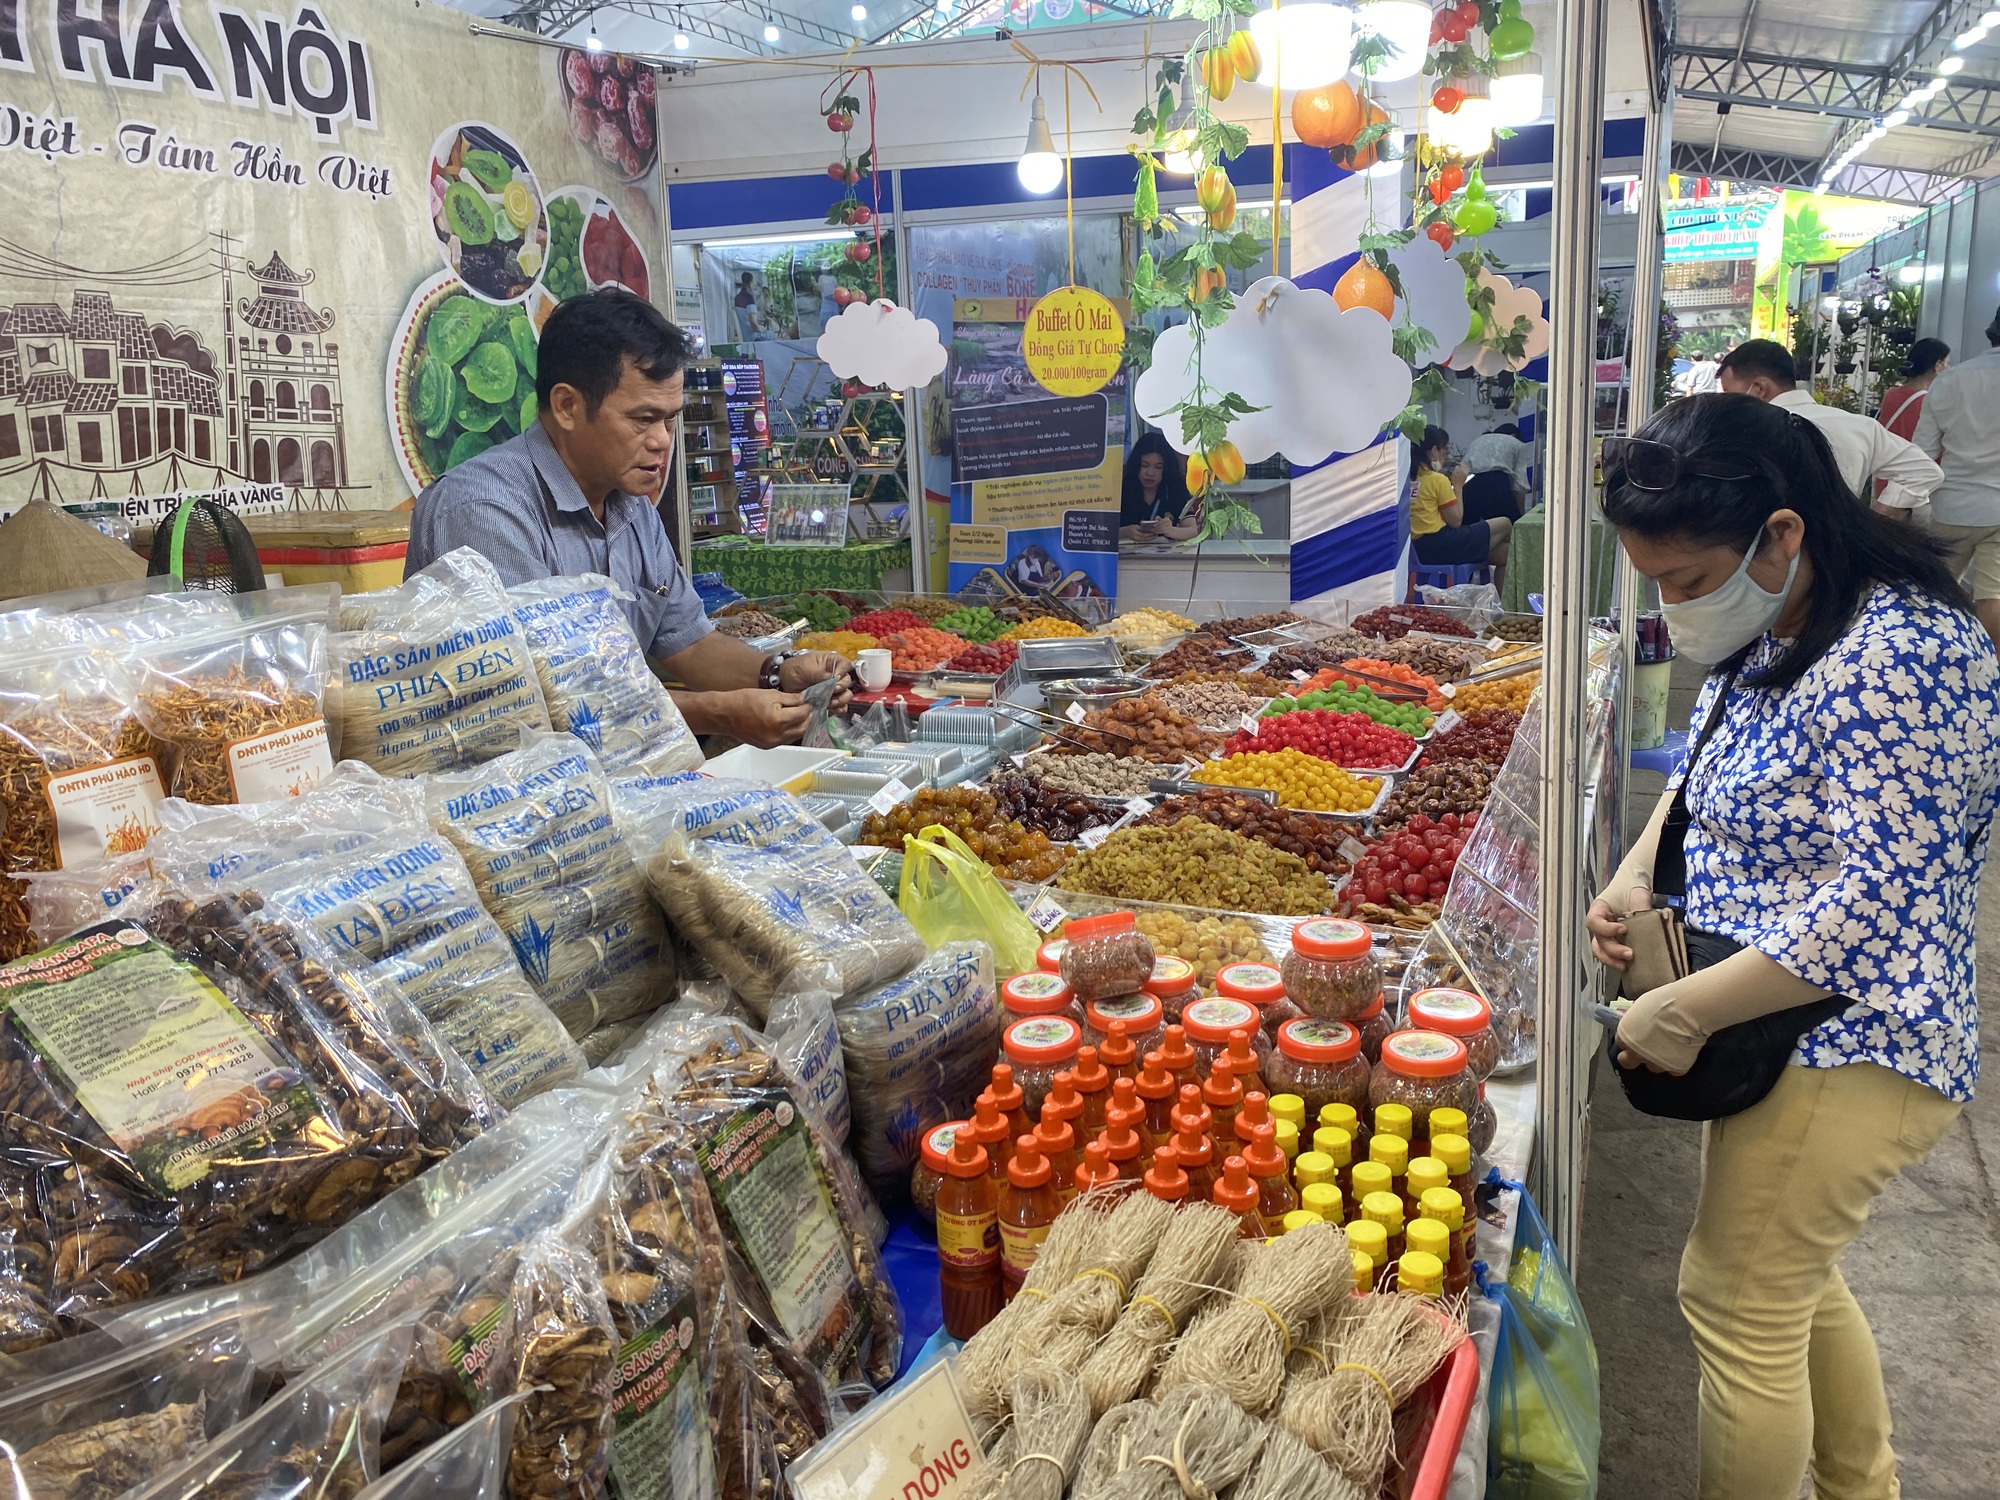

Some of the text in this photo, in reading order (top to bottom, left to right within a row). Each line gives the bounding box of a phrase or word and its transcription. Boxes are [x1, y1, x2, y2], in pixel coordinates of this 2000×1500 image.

[219, 8, 372, 135] NỘI
[119, 123, 218, 173] Tâm
[230, 140, 306, 185] Hồn
[318, 155, 392, 200] Việt
[1037, 308, 1072, 332] Buffet
[1075, 302, 1085, 331] Ô
[1089, 307, 1112, 330] Mai
[1029, 337, 1119, 359] Đồng Giá Tự Chọn
[953, 366, 996, 392] Làng
[1042, 366, 1107, 381] 20.000/100gram
[121, 497, 149, 521] IỆN
[240, 485, 284, 502] VÀNG
[348, 615, 515, 684] ĐẶC SẢN MIẾN DONG
[375, 647, 514, 710] PHIA ĐÉN
[376, 719, 400, 737] 100
[403, 714, 416, 727] %
[418, 703, 445, 723] TINH
[471, 687, 495, 704] CỦA
[237, 742, 268, 759] DNTN
[268, 733, 291, 750] PHÚ
[291, 729, 314, 743] HÀO
[57, 777, 91, 795] DNTN
[90, 770, 114, 787] PHÚ
[115, 766, 137, 781] HÀO
[137, 763, 152, 775] HD
[446, 791, 480, 821] ĐẶC
[486, 821, 590, 874] 100 % TINH BỘT CỦA
[1089, 832, 1108, 847] Nho
[387, 841, 442, 878] DONG
[379, 874, 455, 927] ĐÉN
[64, 931, 115, 957] SAPA
[604, 929, 612, 944] 1
[31, 957, 84, 980] HƯƠNG
[884, 985, 942, 1032] PHIA
[916, 1020, 936, 1041] TINH
[126, 1074, 151, 1090] Nhận
[152, 1064, 174, 1079] Ship
[175, 1053, 196, 1068] COD
[217, 1035, 240, 1051] quốc
[228, 1051, 255, 1068] 2828
[473, 1033, 516, 1067] 1 Kg
[176, 1061, 204, 1080] 0979
[266, 1102, 289, 1118] HD
[745, 1107, 775, 1137] SAPA
[462, 1338, 491, 1374] ĐẶC
[621, 1352, 654, 1383] SẢN
[624, 1367, 665, 1404] HƯƠNG
